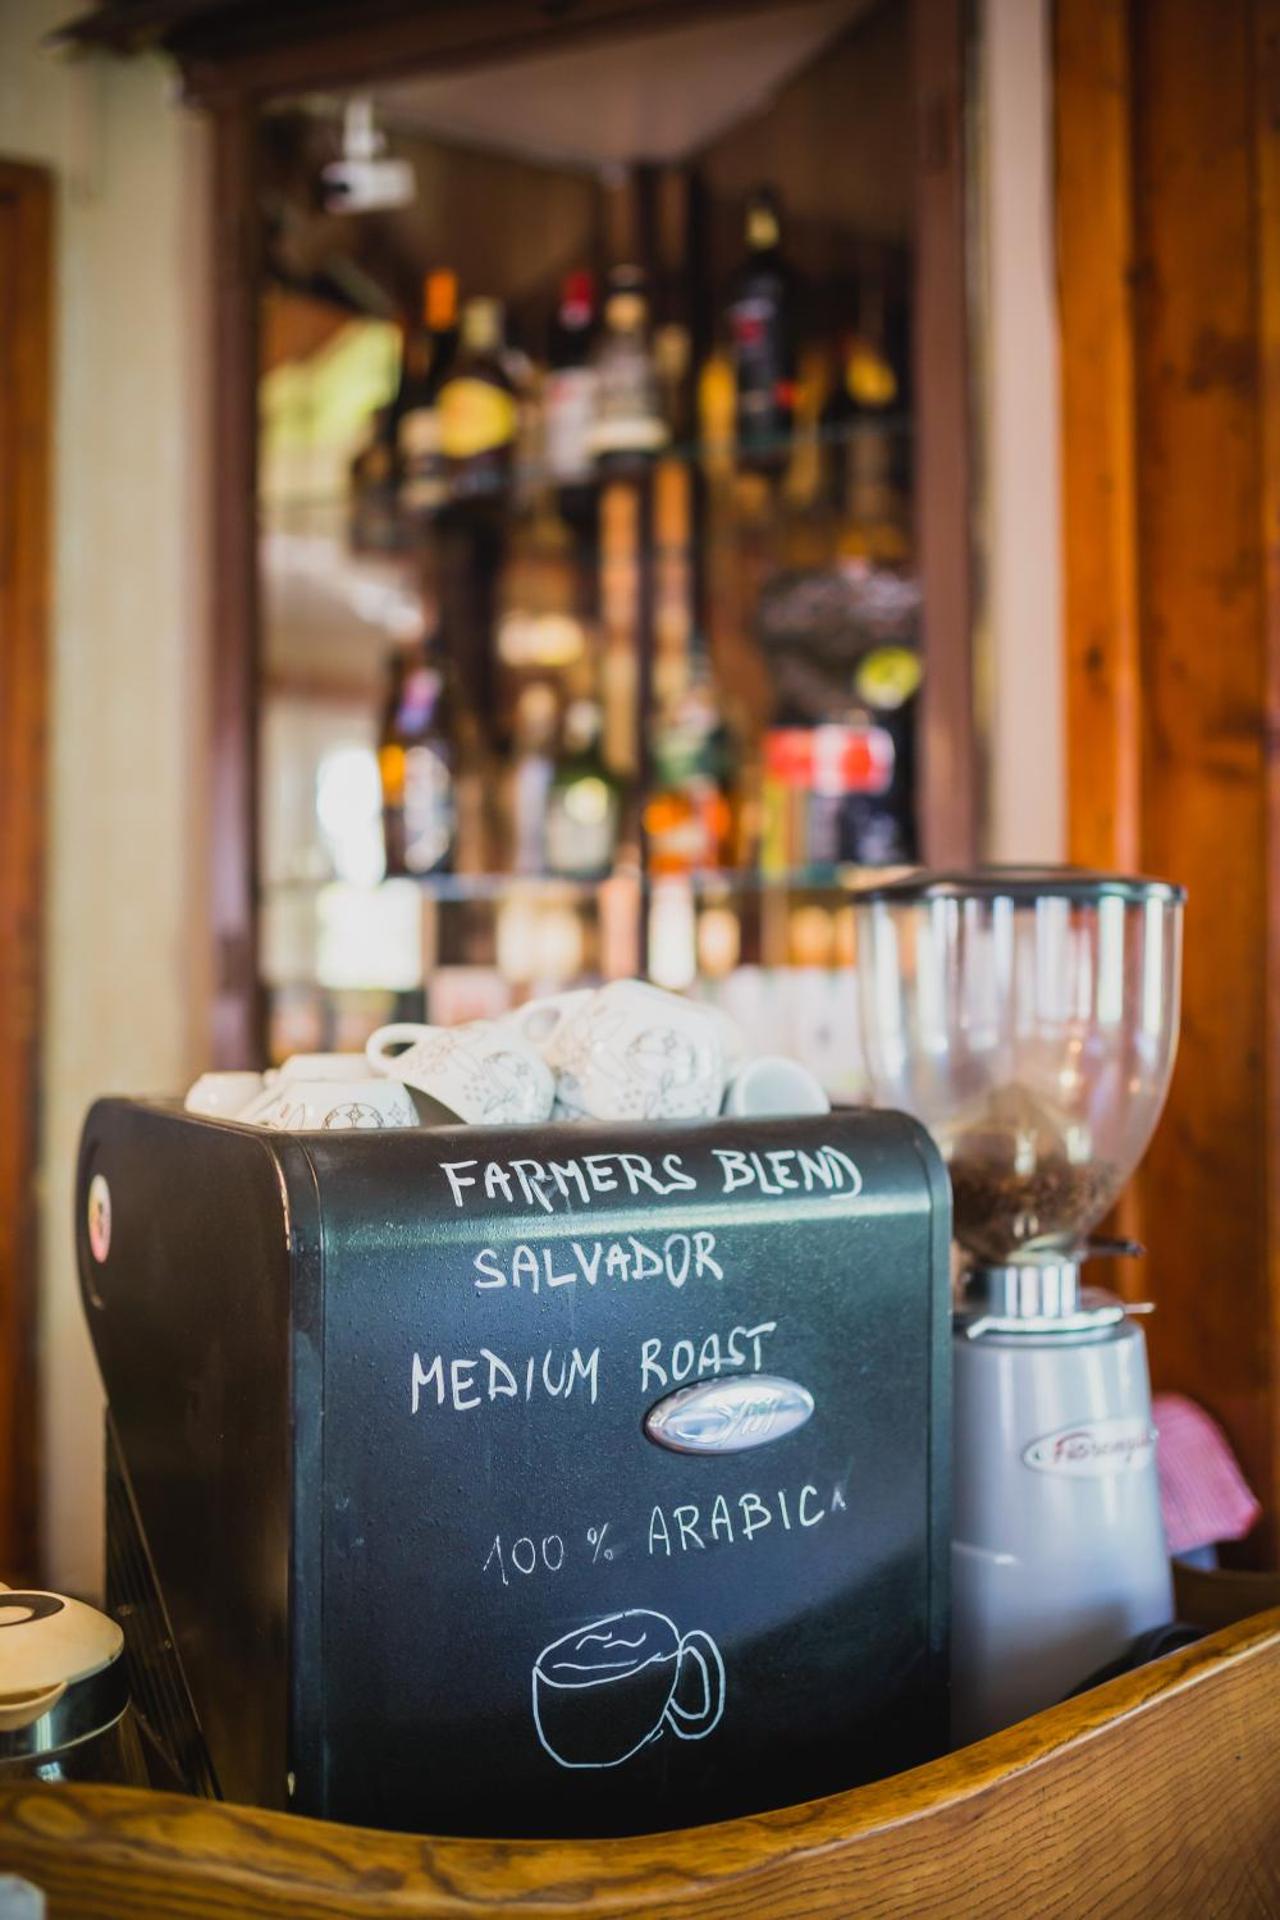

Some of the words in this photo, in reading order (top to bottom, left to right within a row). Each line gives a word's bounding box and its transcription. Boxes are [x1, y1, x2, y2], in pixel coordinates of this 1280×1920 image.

[440, 1154, 697, 1212] FARMERS
[712, 1146, 863, 1199] BLEND
[474, 1232, 724, 1294] SALVADOR
[411, 1348, 600, 1414] MEDIUM
[641, 1322, 777, 1393] ROAST
[483, 1535, 565, 1585] 100
[587, 1523, 615, 1564] %
